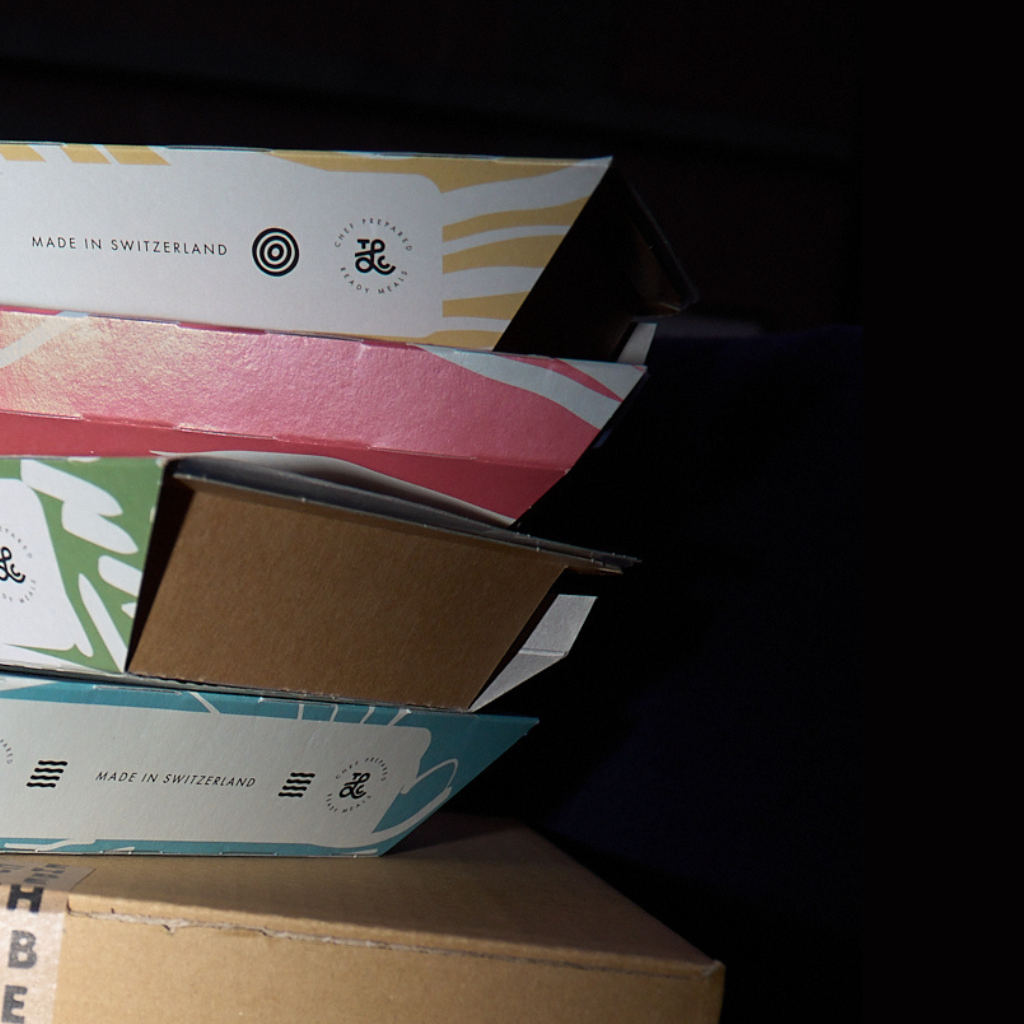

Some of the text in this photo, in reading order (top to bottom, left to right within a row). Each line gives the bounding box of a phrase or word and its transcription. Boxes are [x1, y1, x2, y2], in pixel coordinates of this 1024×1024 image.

[32, 236, 228, 256] MADE IN SWITZERLAND
[95, 771, 256, 788] MADE IN SWITZERLAND
